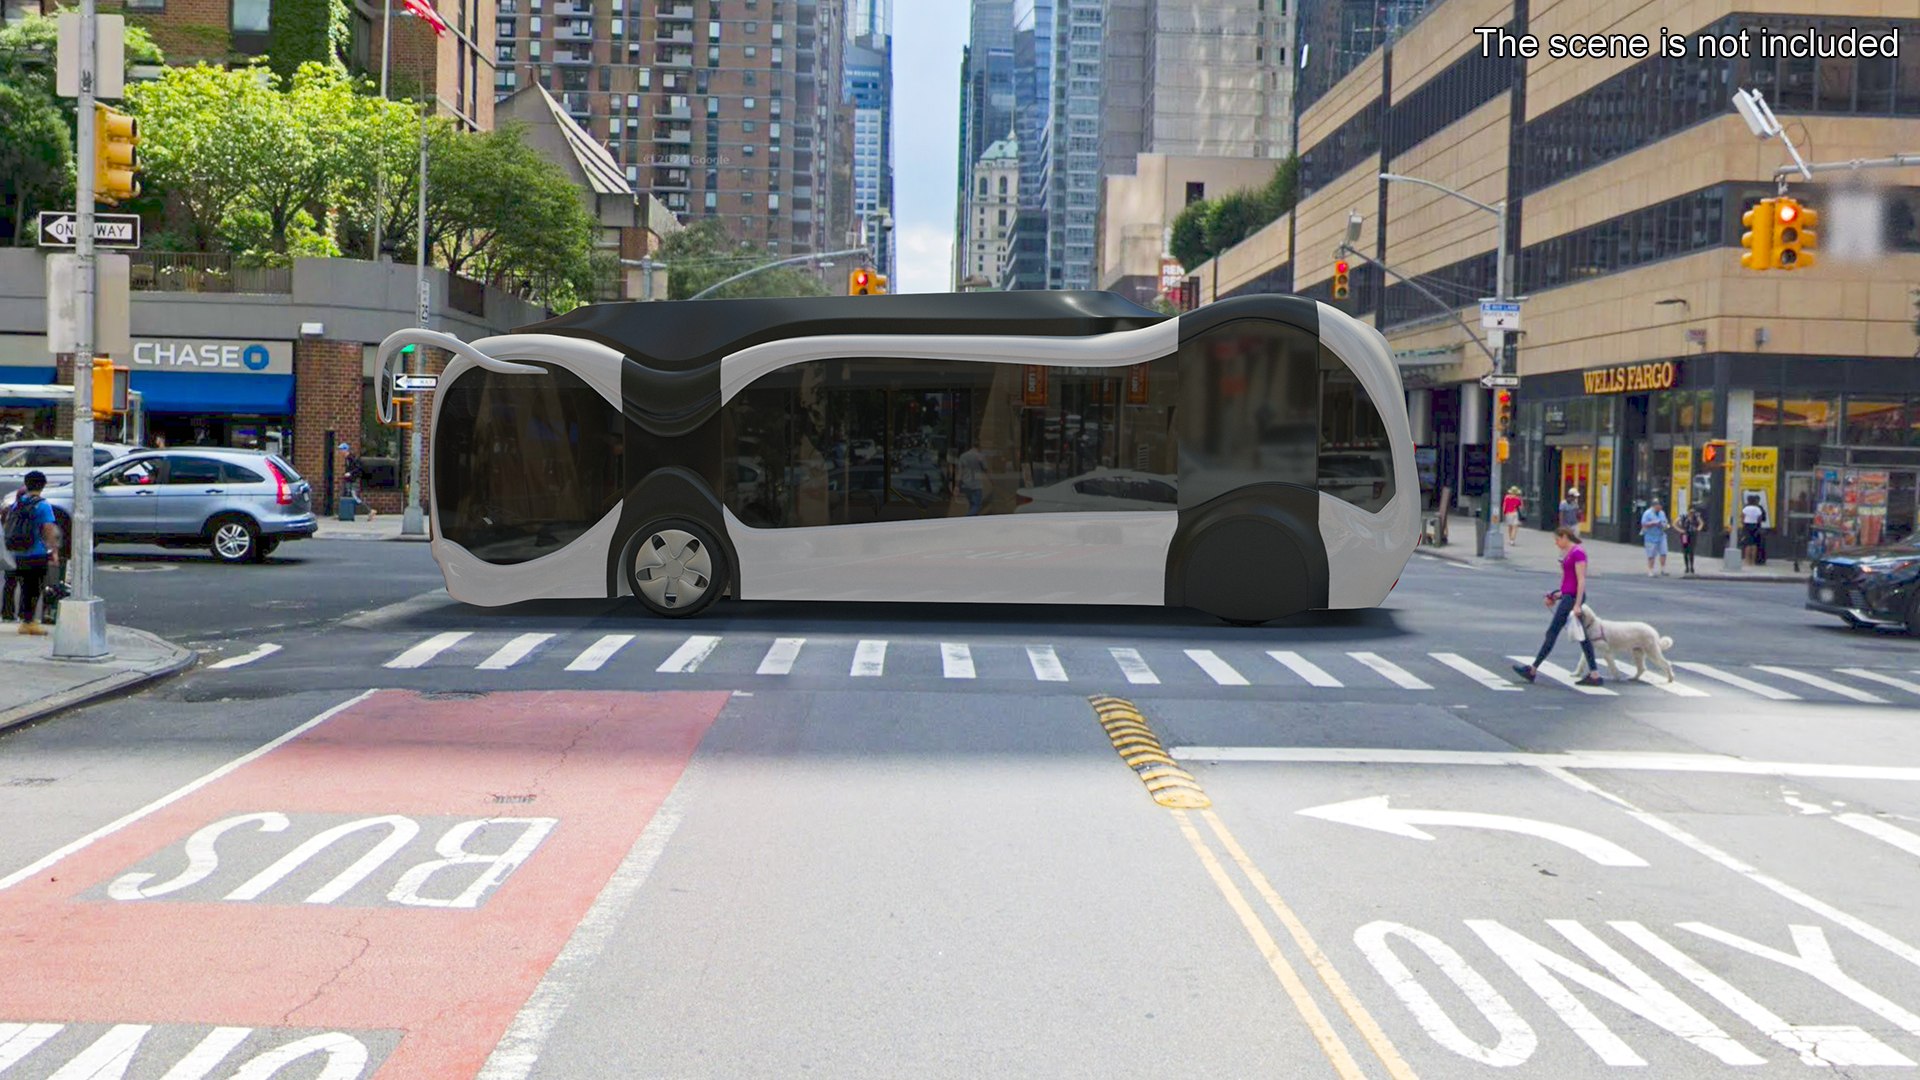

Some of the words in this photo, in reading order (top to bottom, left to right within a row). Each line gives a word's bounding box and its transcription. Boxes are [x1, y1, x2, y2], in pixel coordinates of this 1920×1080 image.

[96, 225, 126, 237] WAY
[133, 342, 240, 368] CHASE
[1583, 367, 1625, 394] WELLS
[1626, 361, 1673, 390] FARGO
[1742, 462, 1775, 474] here!
[108, 812, 560, 908] BUS
[1354, 920, 1920, 1067] ONLY
